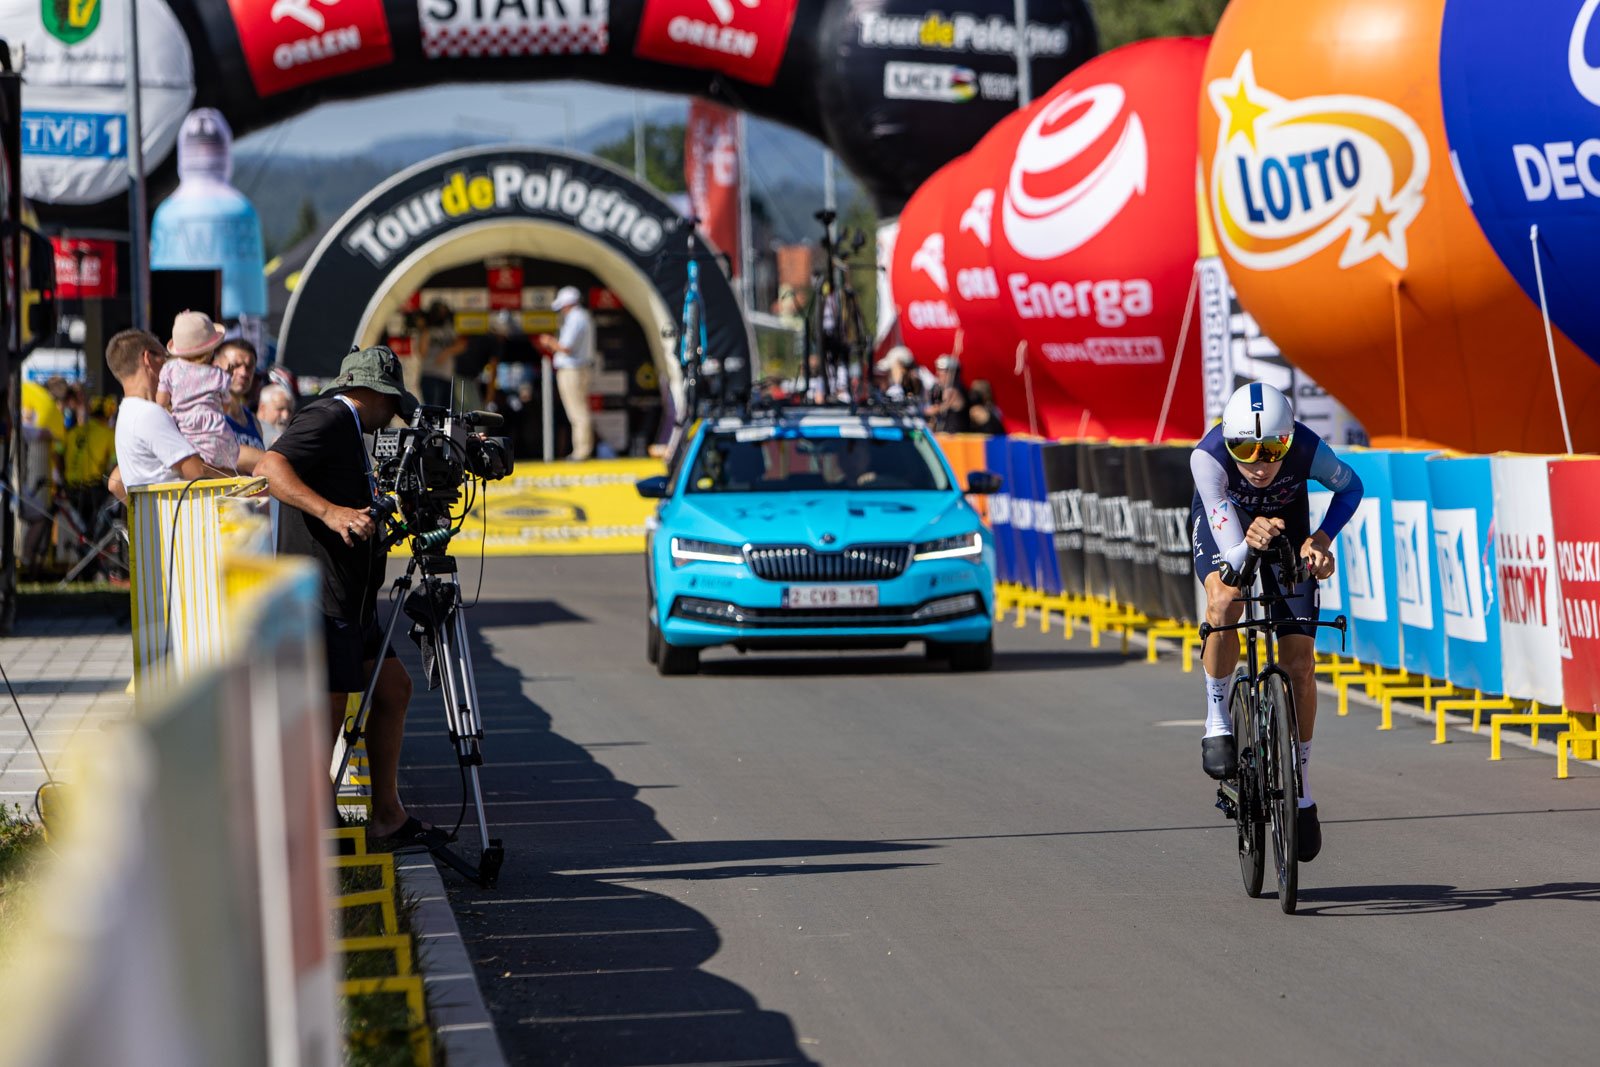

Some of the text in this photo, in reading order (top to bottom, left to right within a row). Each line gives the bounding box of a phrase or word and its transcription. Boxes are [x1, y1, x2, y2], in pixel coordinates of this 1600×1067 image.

[273, 24, 362, 70] ORLEN
[668, 15, 758, 58] ORLEN
[859, 13, 1068, 53] TourdePolone
[26, 117, 121, 155] TVP 1
[1238, 140, 1361, 223] LOTTO
[1512, 138, 1600, 201] DEC
[348, 165, 663, 263] TourdePologne
[1007, 273, 1153, 328] Energa
[1557, 541, 1600, 582] POLSKI
[1565, 598, 1600, 640] RADI
